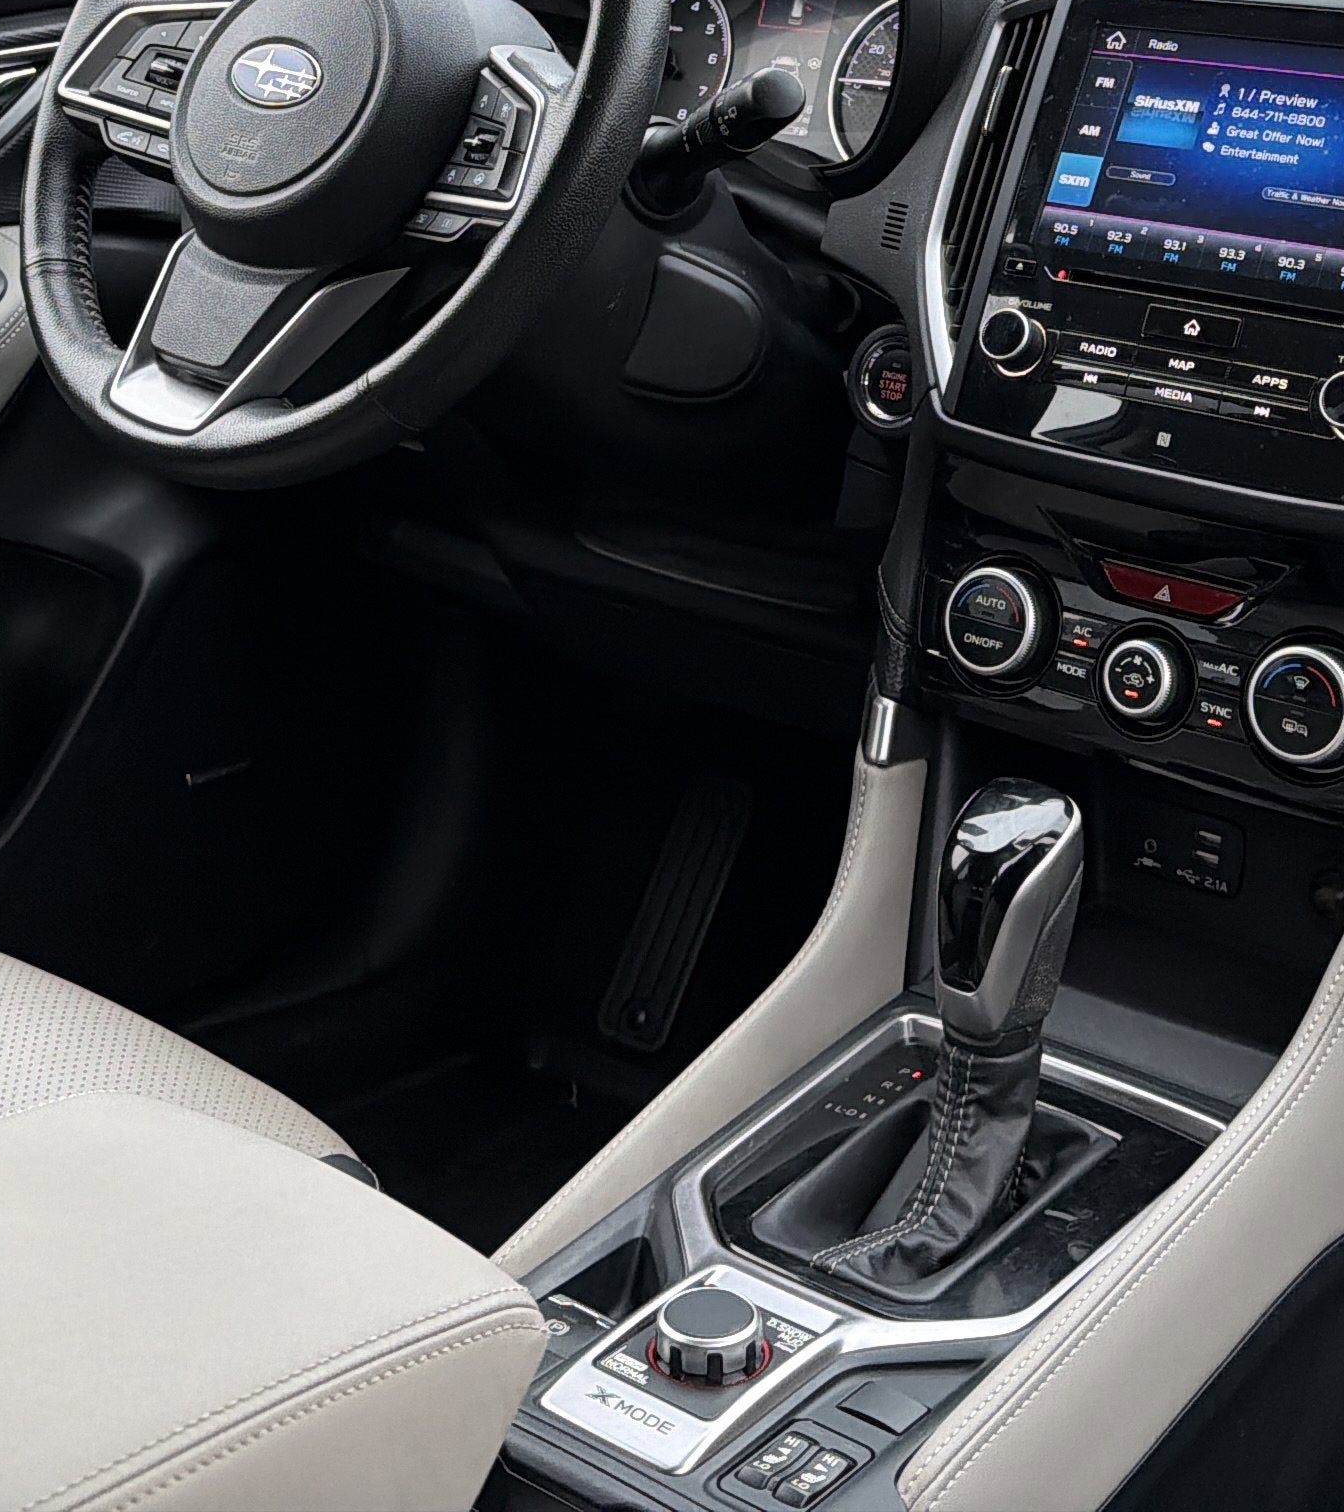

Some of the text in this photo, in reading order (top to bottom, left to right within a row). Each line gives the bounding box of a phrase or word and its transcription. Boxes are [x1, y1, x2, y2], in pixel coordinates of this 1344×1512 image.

[690, 1, 701, 12] 4
[705, 23, 716, 35] 5
[868, 44, 885, 55] 20
[1148, 38, 1179, 52] Radio
[707, 53, 719, 65] 6
[1094, 76, 1116, 88] FM
[698, 85, 708, 97] 7
[1133, 94, 1201, 114] SiriusXM
[1237, 88, 1244, 100] 1
[1259, 90, 1319, 110] Preview
[676, 108, 688, 120] 8
[1231, 106, 1326, 128] 844-711-8800
[1079, 124, 1102, 137] AM
[1226, 125, 1326, 148] Great Offer Now!
[229, 132, 259, 146] SRS
[218, 144, 259, 162] AIRBAG
[1220, 144, 1299, 165] Entertainment
[1058, 173, 1091, 188] sxm
[1053, 222, 1078, 235] 90.5
[1054, 235, 1070, 247] FM
[1107, 230, 1132, 244] 92.3
[1108, 244, 1124, 255] FM
[1163, 239, 1187, 252] 93.1
[1163, 252, 1179, 263] FM
[1218, 247, 1246, 261] 93.3
[1220, 261, 1237, 273] FM
[1277, 256, 1306, 270] 90.3
[1279, 270, 1297, 282] FM
[1079, 341, 1117, 358] RADIO
[1168, 357, 1195, 372] MAP
[882, 370, 909, 381] ENGINE
[1252, 374, 1289, 390] APPS
[879, 379, 907, 393] START
[880, 390, 903, 401] STOP
[1154, 387, 1193, 404] MEDIA
[975, 594, 1006, 610] AUTO
[1072, 624, 1093, 638] A/C
[963, 632, 1004, 650] ON/OFF
[1056, 662, 1087, 679] MODE
[1219, 662, 1240, 676] A/C
[1200, 701, 1233, 719] SYNC
[1204, 876, 1228, 893] 2.1A
[898, 1067, 911, 1075] P
[881, 1080, 894, 1089] R
[863, 1093, 876, 1103] N
[777, 1332, 805, 1348] MUD
[604, 1357, 649, 1386] NORMAL
[614, 1399, 676, 1436] MODE
[784, 1436, 801, 1449] HI
[753, 1460, 771, 1471] LO
[821, 1453, 841, 1468] HI
[791, 1478, 811, 1490] LO
